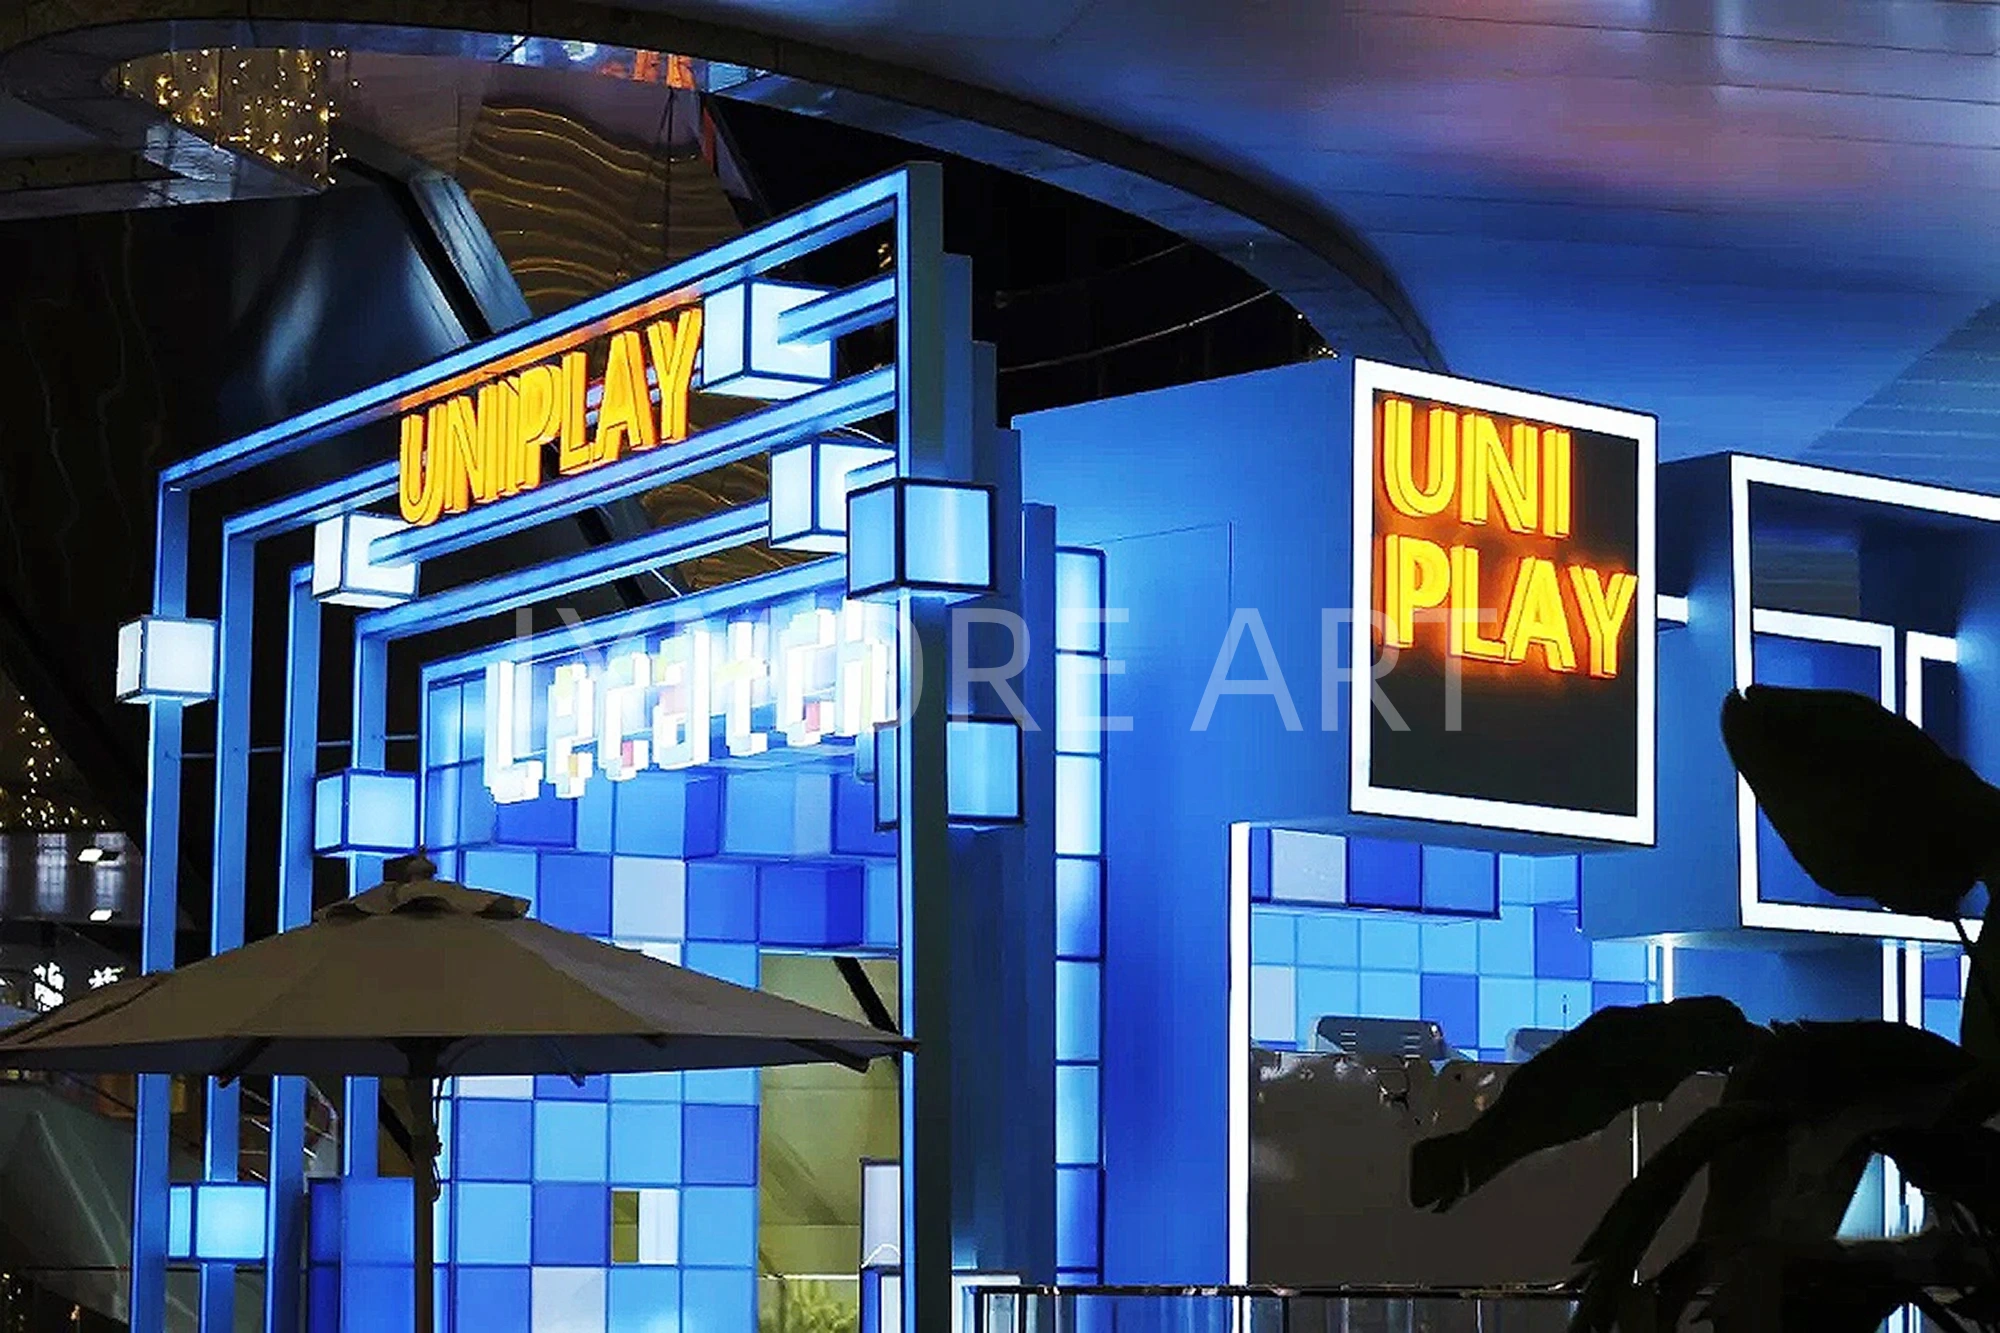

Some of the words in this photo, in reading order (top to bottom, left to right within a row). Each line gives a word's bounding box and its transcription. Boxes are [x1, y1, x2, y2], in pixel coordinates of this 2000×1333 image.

[400, 308, 703, 526] UNIPLAY
[1383, 398, 1571, 538] UNI
[1384, 533, 1639, 679] PLAY
